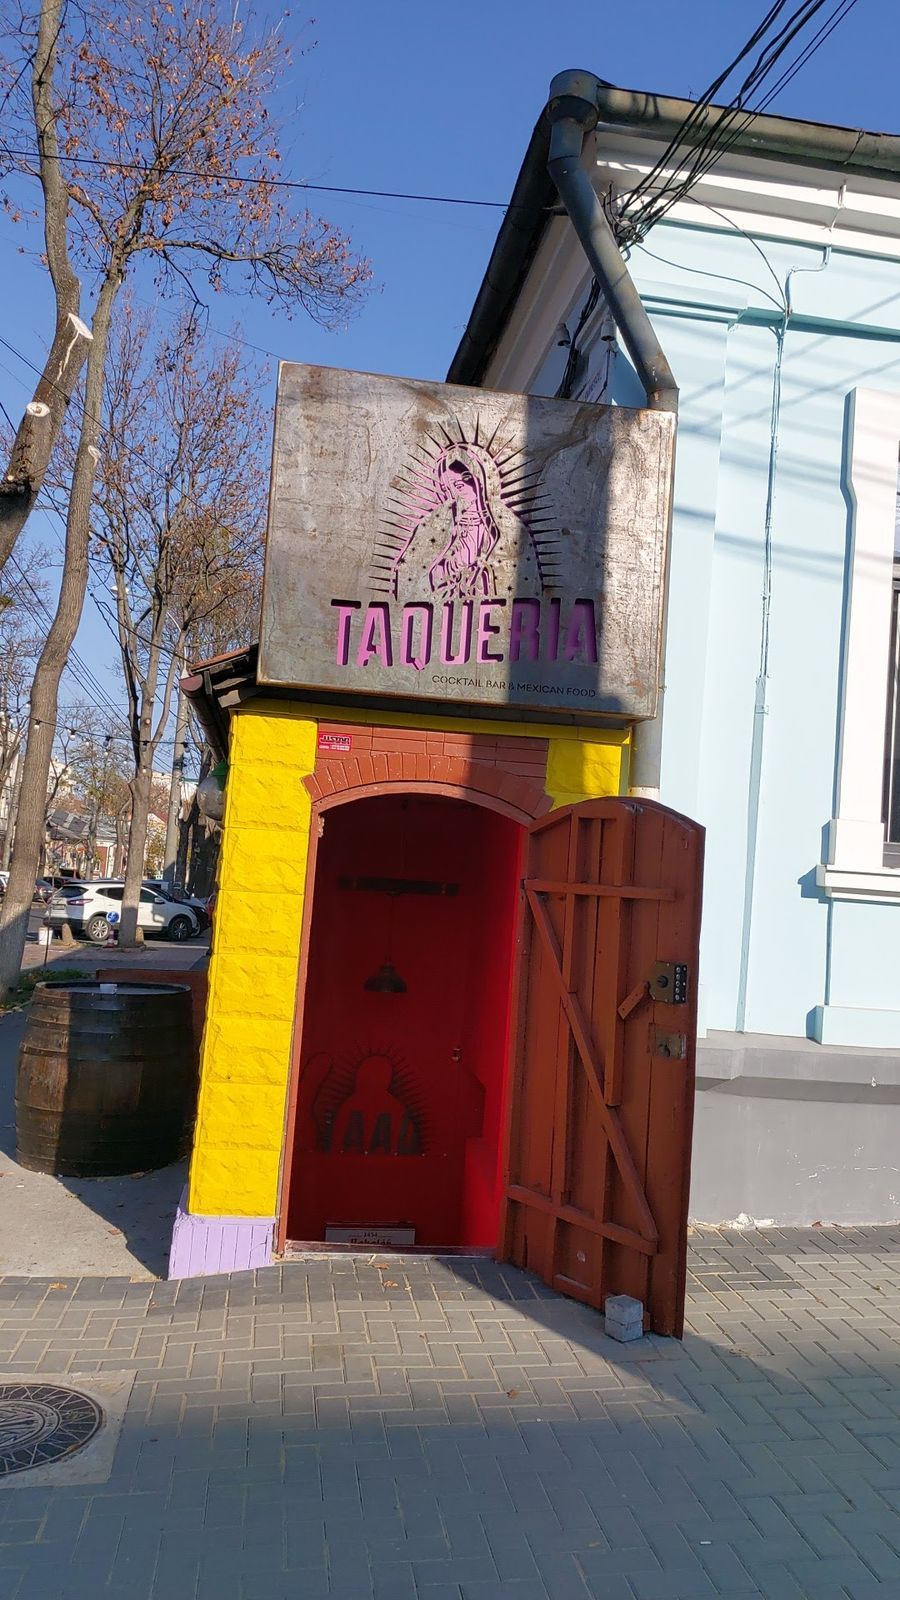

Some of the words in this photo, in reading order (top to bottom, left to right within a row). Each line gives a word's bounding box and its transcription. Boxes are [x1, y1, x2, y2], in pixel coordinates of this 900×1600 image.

[331, 598, 597, 671] TAQUERIA
[432, 675, 483, 688] COCKTAIL
[486, 680, 506, 690] BAR
[508, 683, 515, 691] &
[517, 683, 564, 696] MEXICAN
[566, 687, 596, 698] FOOD
